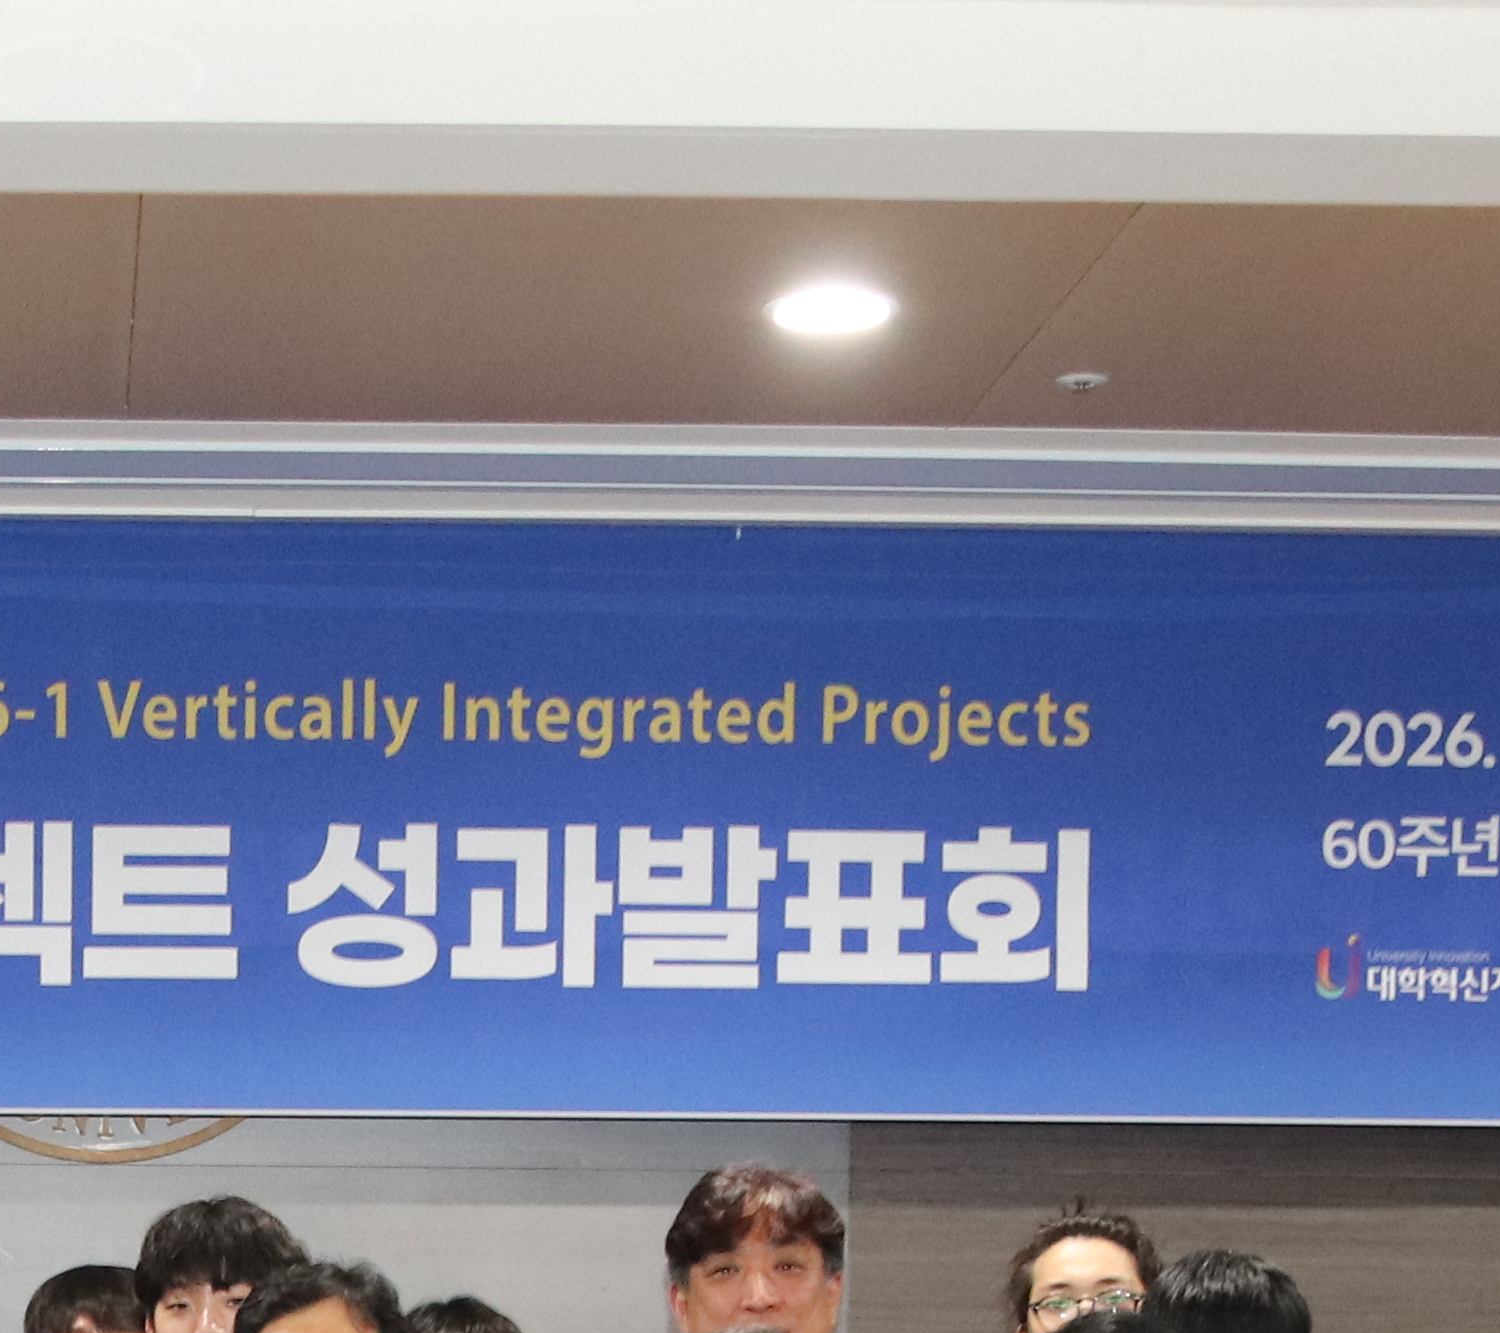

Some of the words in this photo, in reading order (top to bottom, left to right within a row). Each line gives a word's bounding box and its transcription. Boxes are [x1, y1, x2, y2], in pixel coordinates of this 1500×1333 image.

[98, 678, 418, 757] Vertically
[443, 682, 795, 759] Integrated
[823, 685, 1090, 761] Projects
[1326, 711, 1495, 768] 2026.
[288, 823, 1089, 991] 성과발표회
